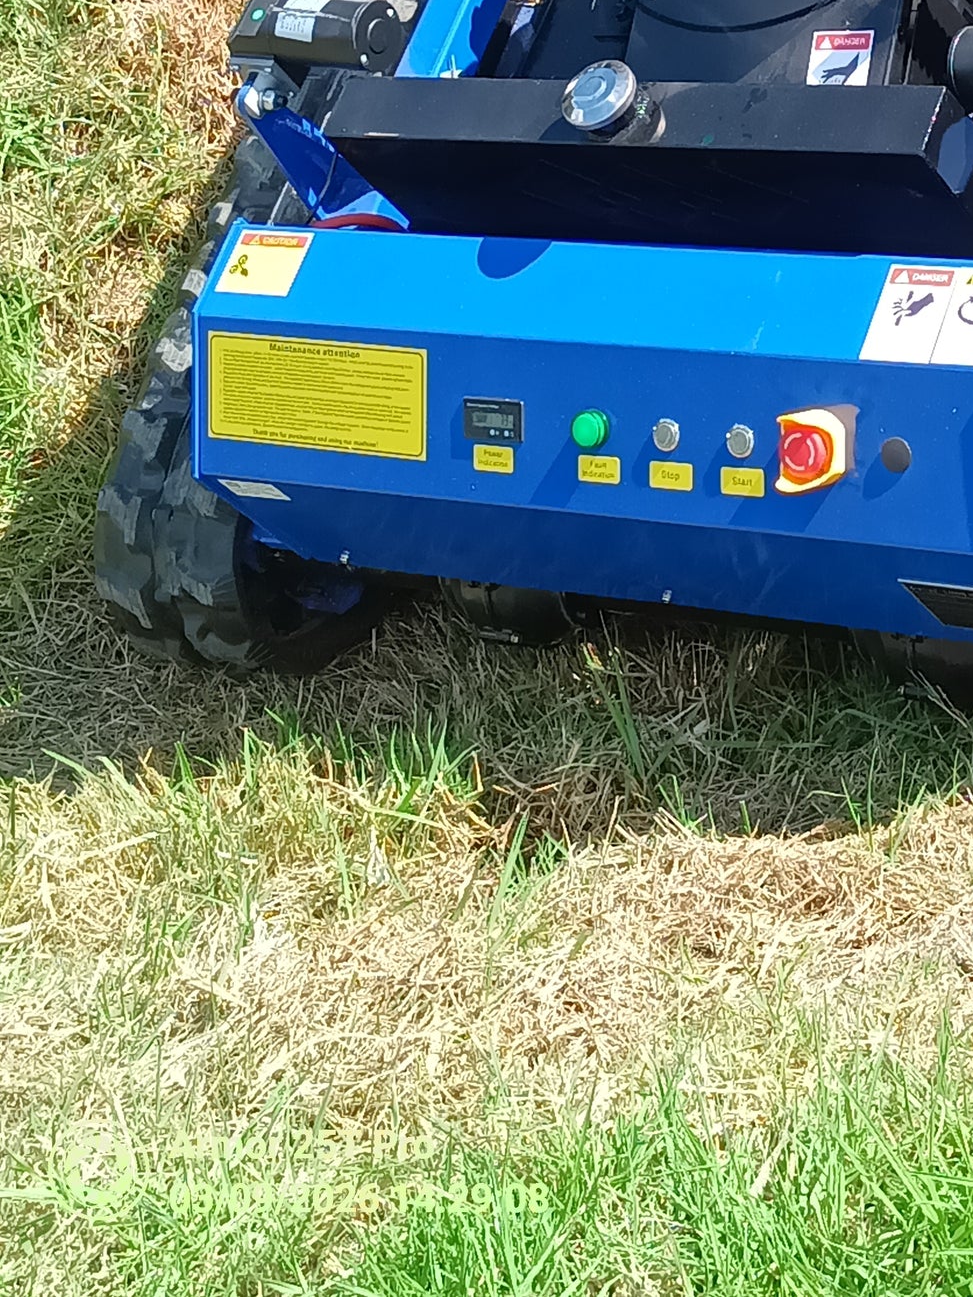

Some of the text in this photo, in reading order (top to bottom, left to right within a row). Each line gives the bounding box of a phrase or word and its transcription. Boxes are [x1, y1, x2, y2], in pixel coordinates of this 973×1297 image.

[833, 37, 866, 47] DANGER
[912, 272, 949, 283] DANGER
[269, 342, 321, 356] Maintenance
[660, 469, 680, 482] Stop
[732, 476, 753, 487] Start
